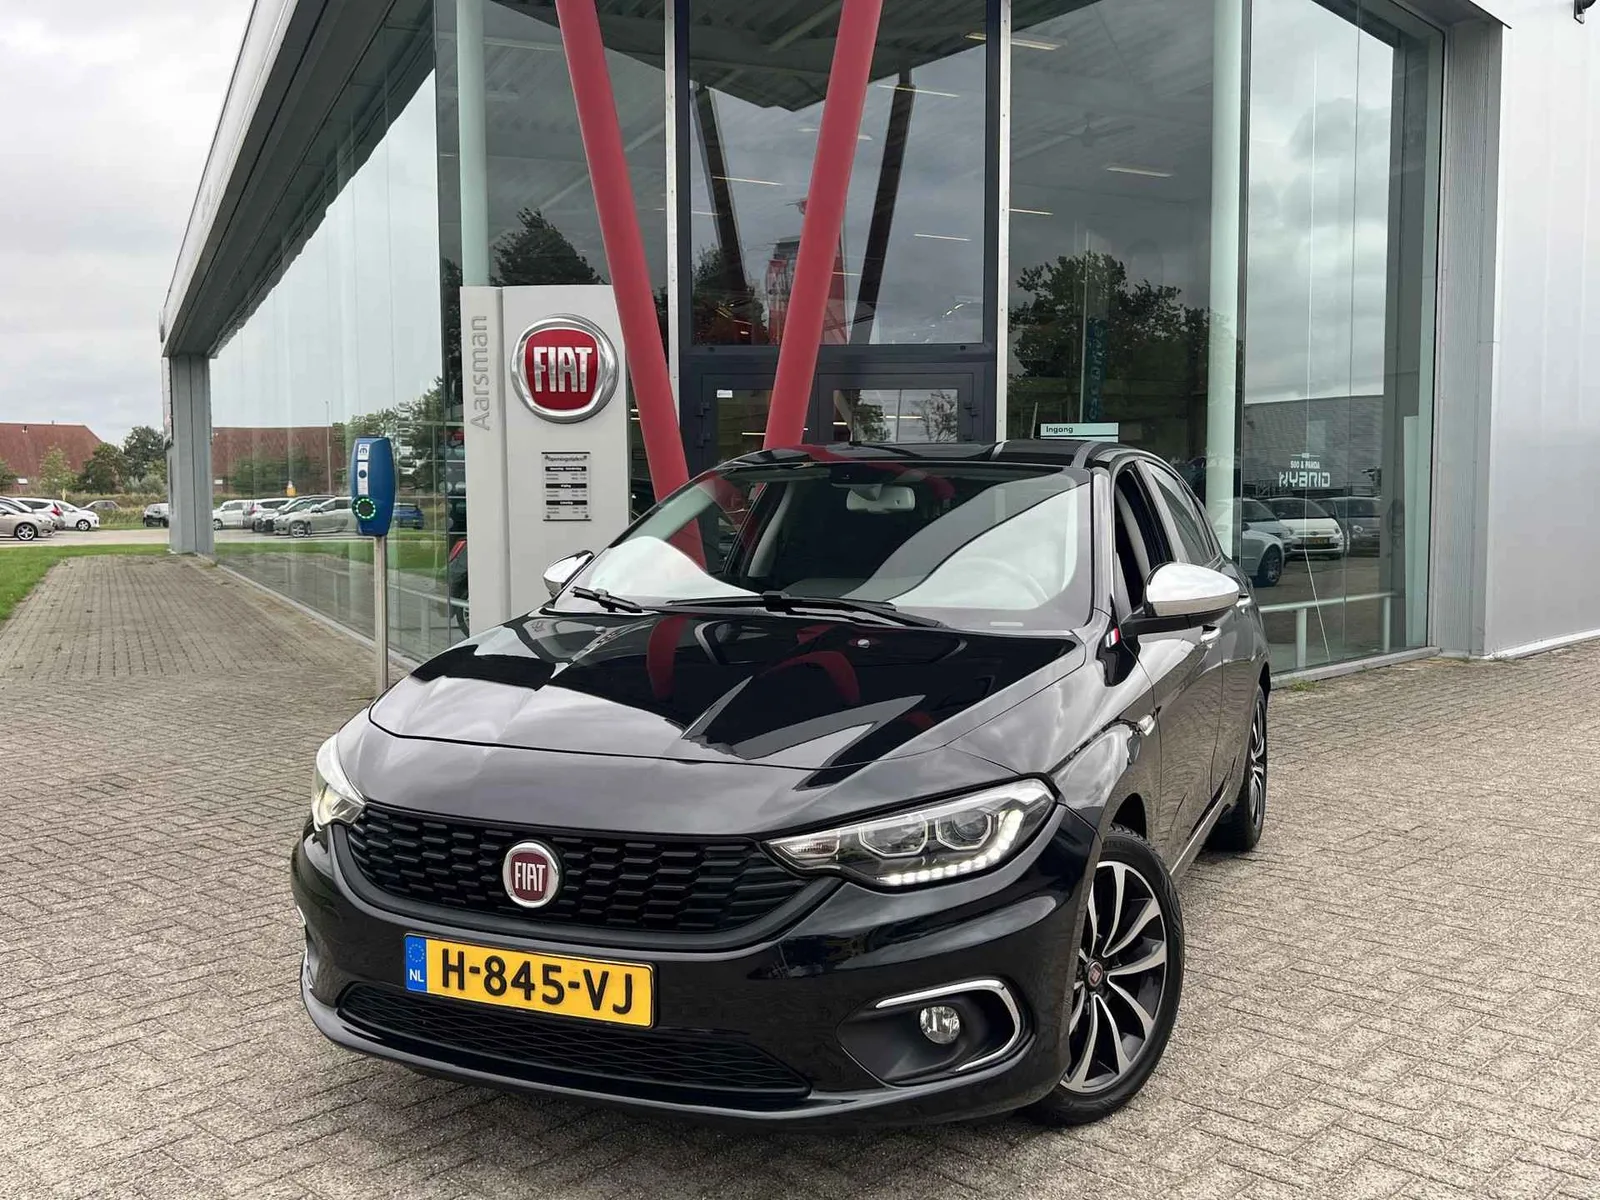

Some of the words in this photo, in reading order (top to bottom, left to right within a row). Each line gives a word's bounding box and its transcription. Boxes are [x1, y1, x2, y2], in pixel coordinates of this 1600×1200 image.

[470, 315, 490, 431] Aarsman
[533, 346, 593, 393] FIAT
[1278, 471, 1331, 488] HYBRID
[514, 861, 547, 892] FIAT
[409, 968, 424, 983] NL
[442, 948, 633, 1015] H-845-VJ
